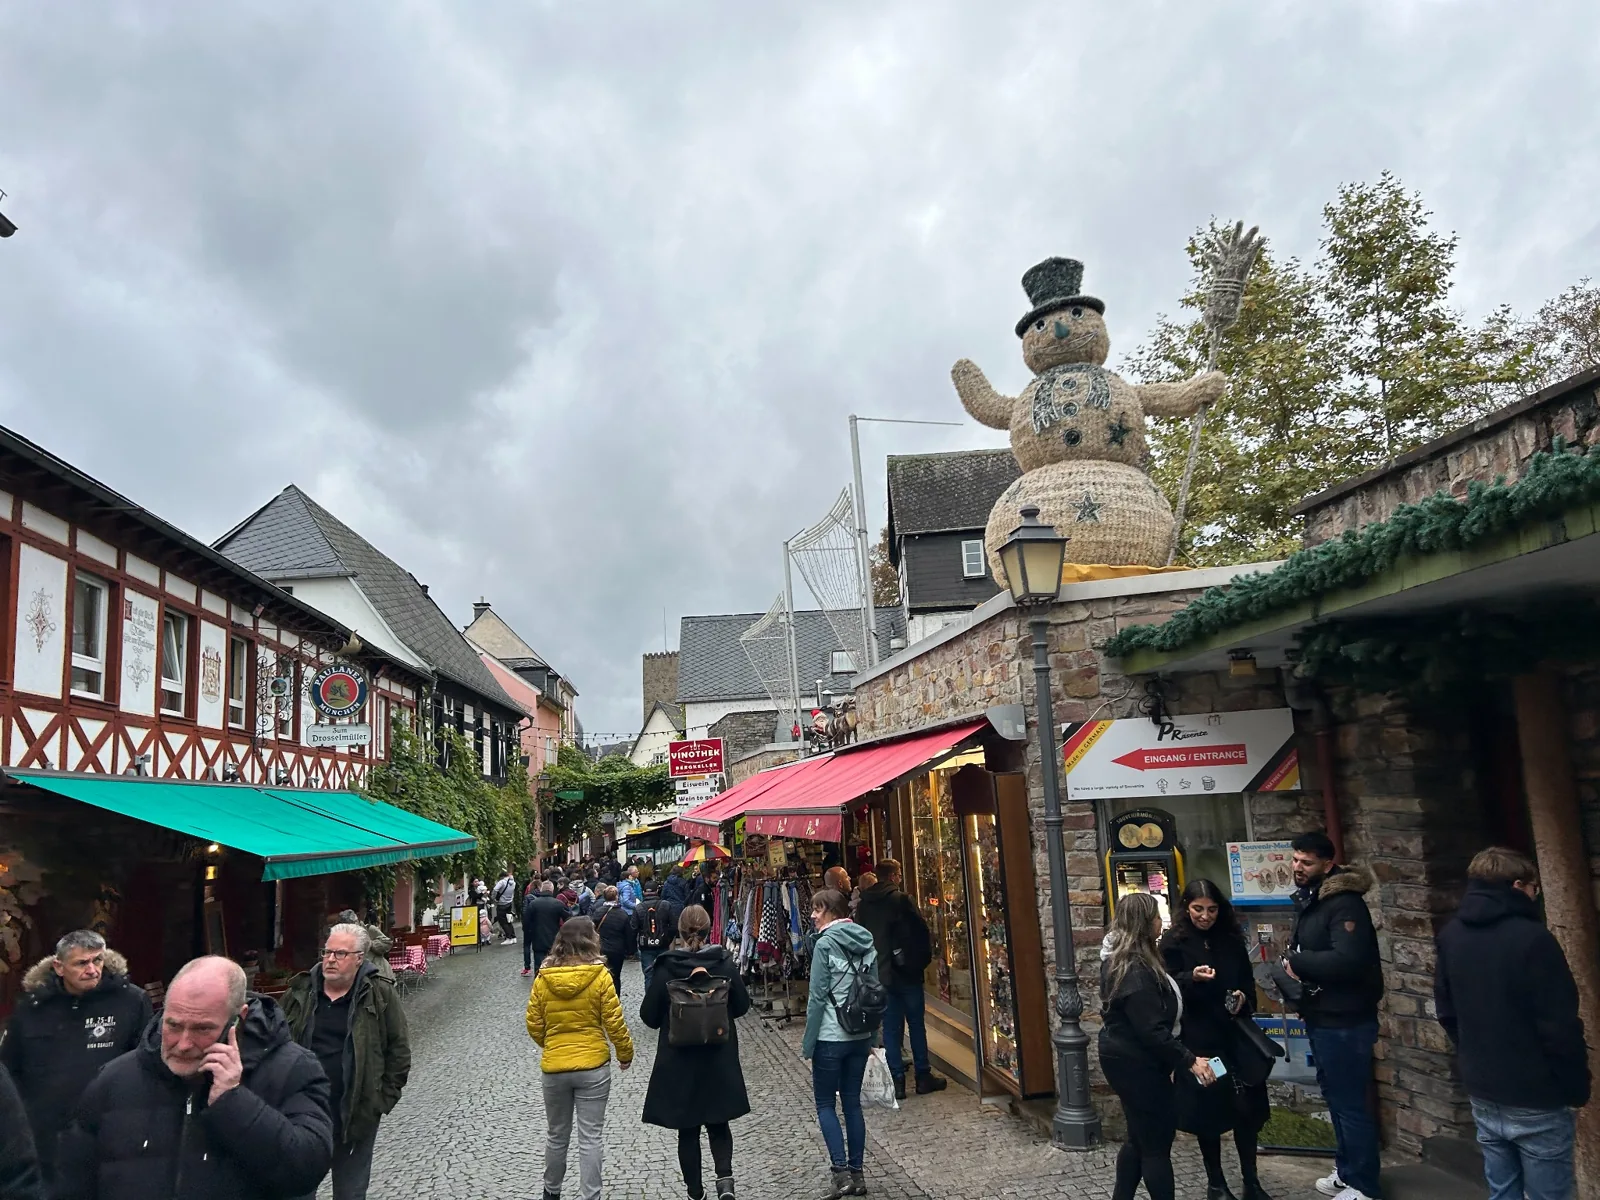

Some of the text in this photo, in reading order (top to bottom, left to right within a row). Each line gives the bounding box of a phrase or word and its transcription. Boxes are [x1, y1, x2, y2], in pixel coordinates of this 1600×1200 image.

[314, 666, 364, 686] PAULANER
[312, 733, 367, 742] Drosselmüller
[1066, 755, 1079, 768] Made
[1083, 723, 1107, 749] GERMANY
[671, 749, 720, 760] VINOTHEK
[1144, 754, 1187, 763] EINGANG
[1194, 750, 1246, 760] ENTRANCE
[675, 762, 718, 771] BERGKELLER
[682, 780, 709, 788] Eiswein
